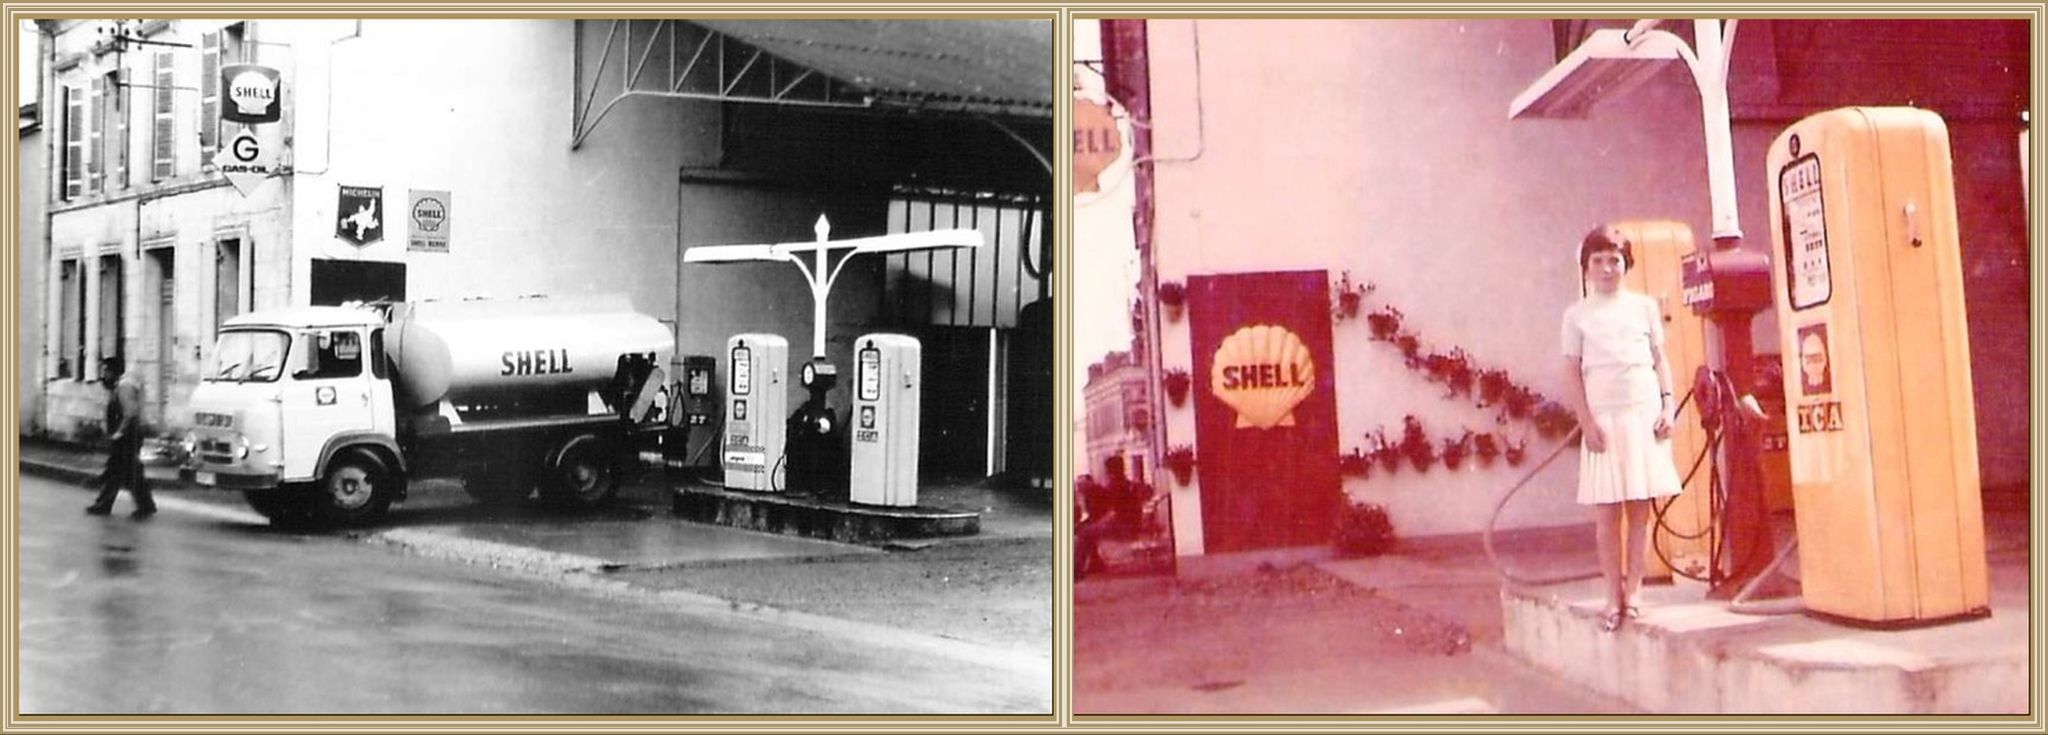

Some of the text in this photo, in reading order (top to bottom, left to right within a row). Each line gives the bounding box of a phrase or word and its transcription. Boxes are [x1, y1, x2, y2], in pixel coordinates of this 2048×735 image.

[235, 86, 272, 99] SHELL
[233, 136, 259, 162] G
[222, 165, 269, 174] GAS-OIL
[342, 188, 380, 199] MICHELIN
[417, 209, 441, 219] SHELL
[501, 348, 573, 376] SHELL
[1222, 363, 1305, 390] SHELL
[1798, 402, 1843, 434] ICA
